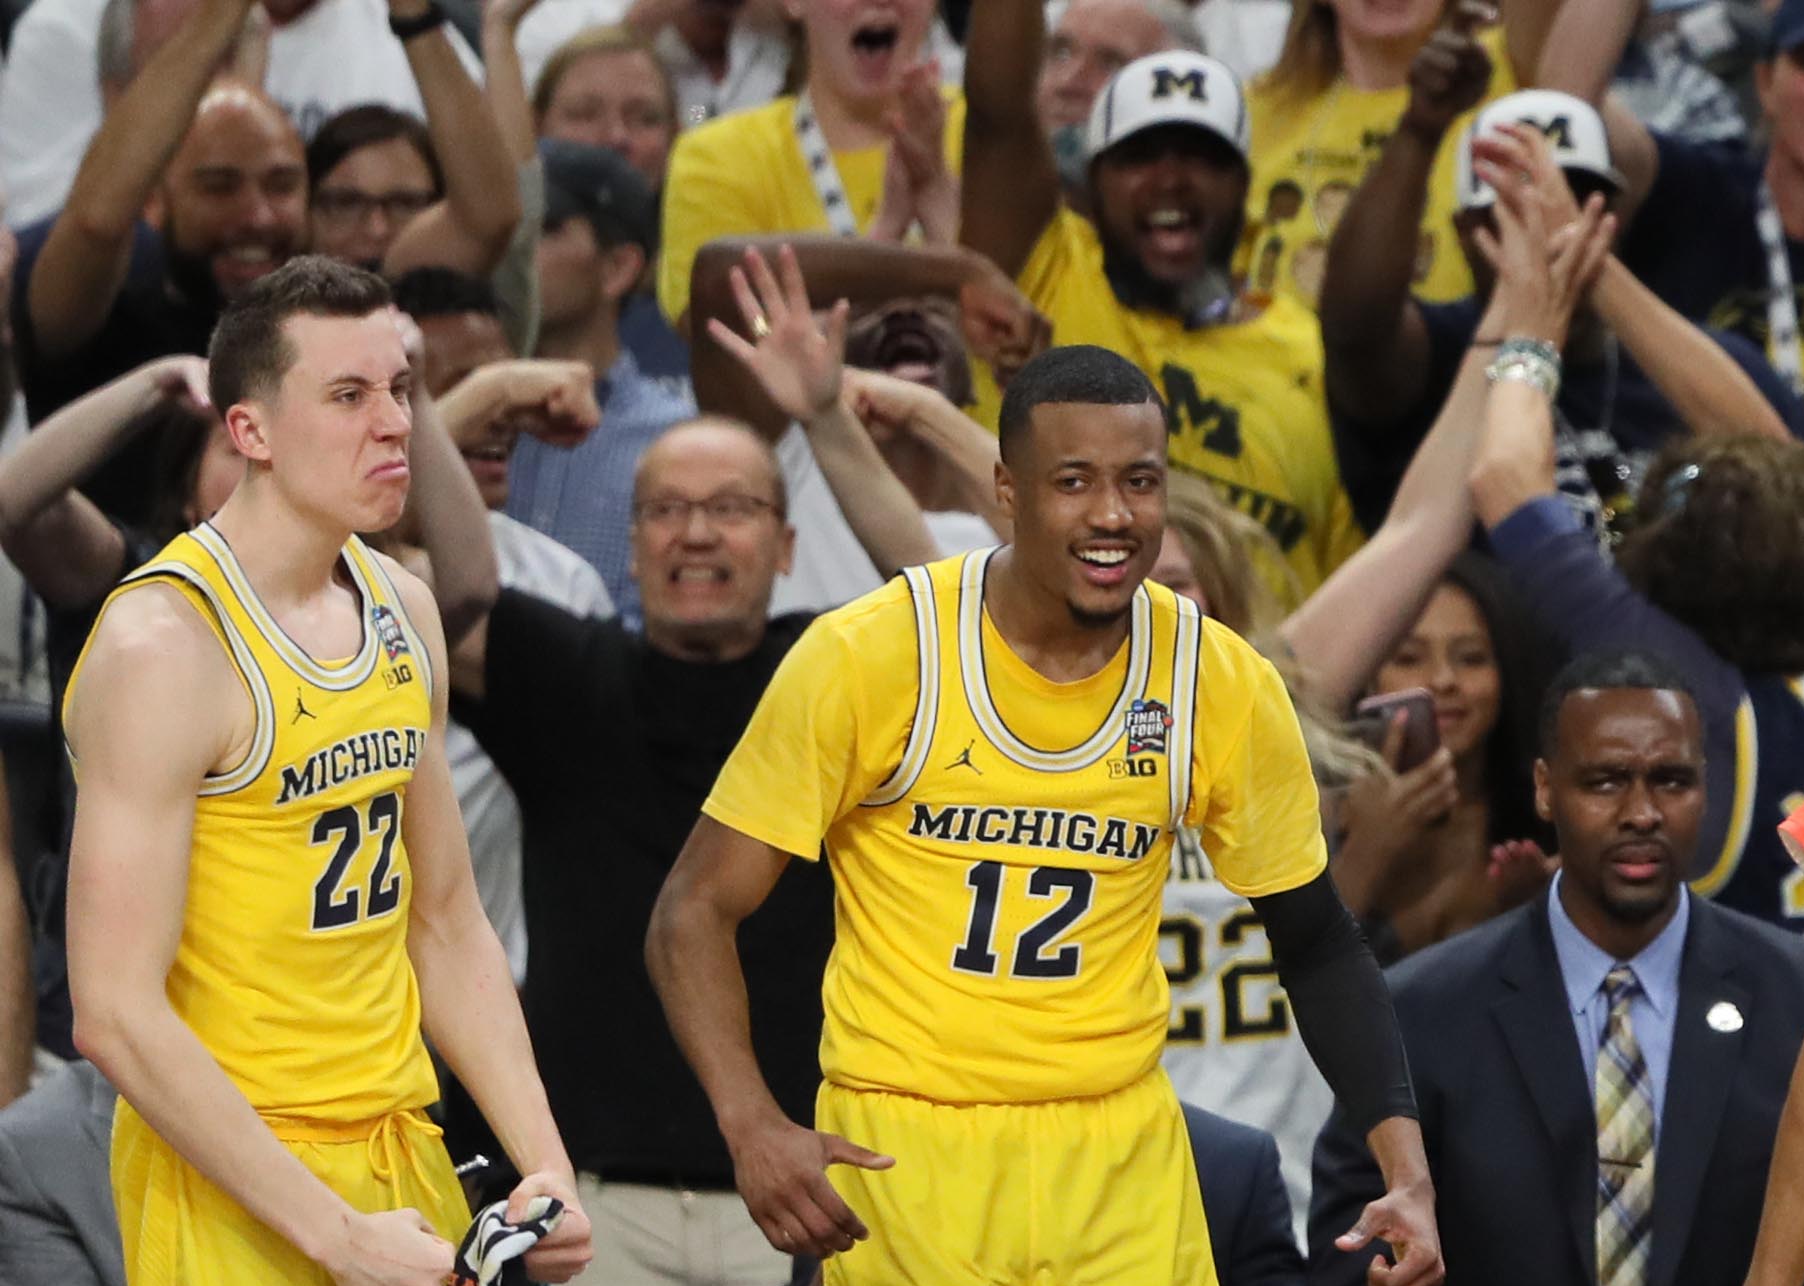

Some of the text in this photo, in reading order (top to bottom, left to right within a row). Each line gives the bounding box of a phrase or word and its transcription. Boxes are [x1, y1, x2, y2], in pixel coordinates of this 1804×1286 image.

[1152, 68, 1208, 102] M
[1162, 373, 1243, 459] M
[1126, 711, 1163, 727] FINAL
[1131, 723, 1165, 738] FOUR
[909, 803, 1159, 860] MICHIGAN
[310, 791, 401, 931] 22
[951, 858, 1095, 980] 12
